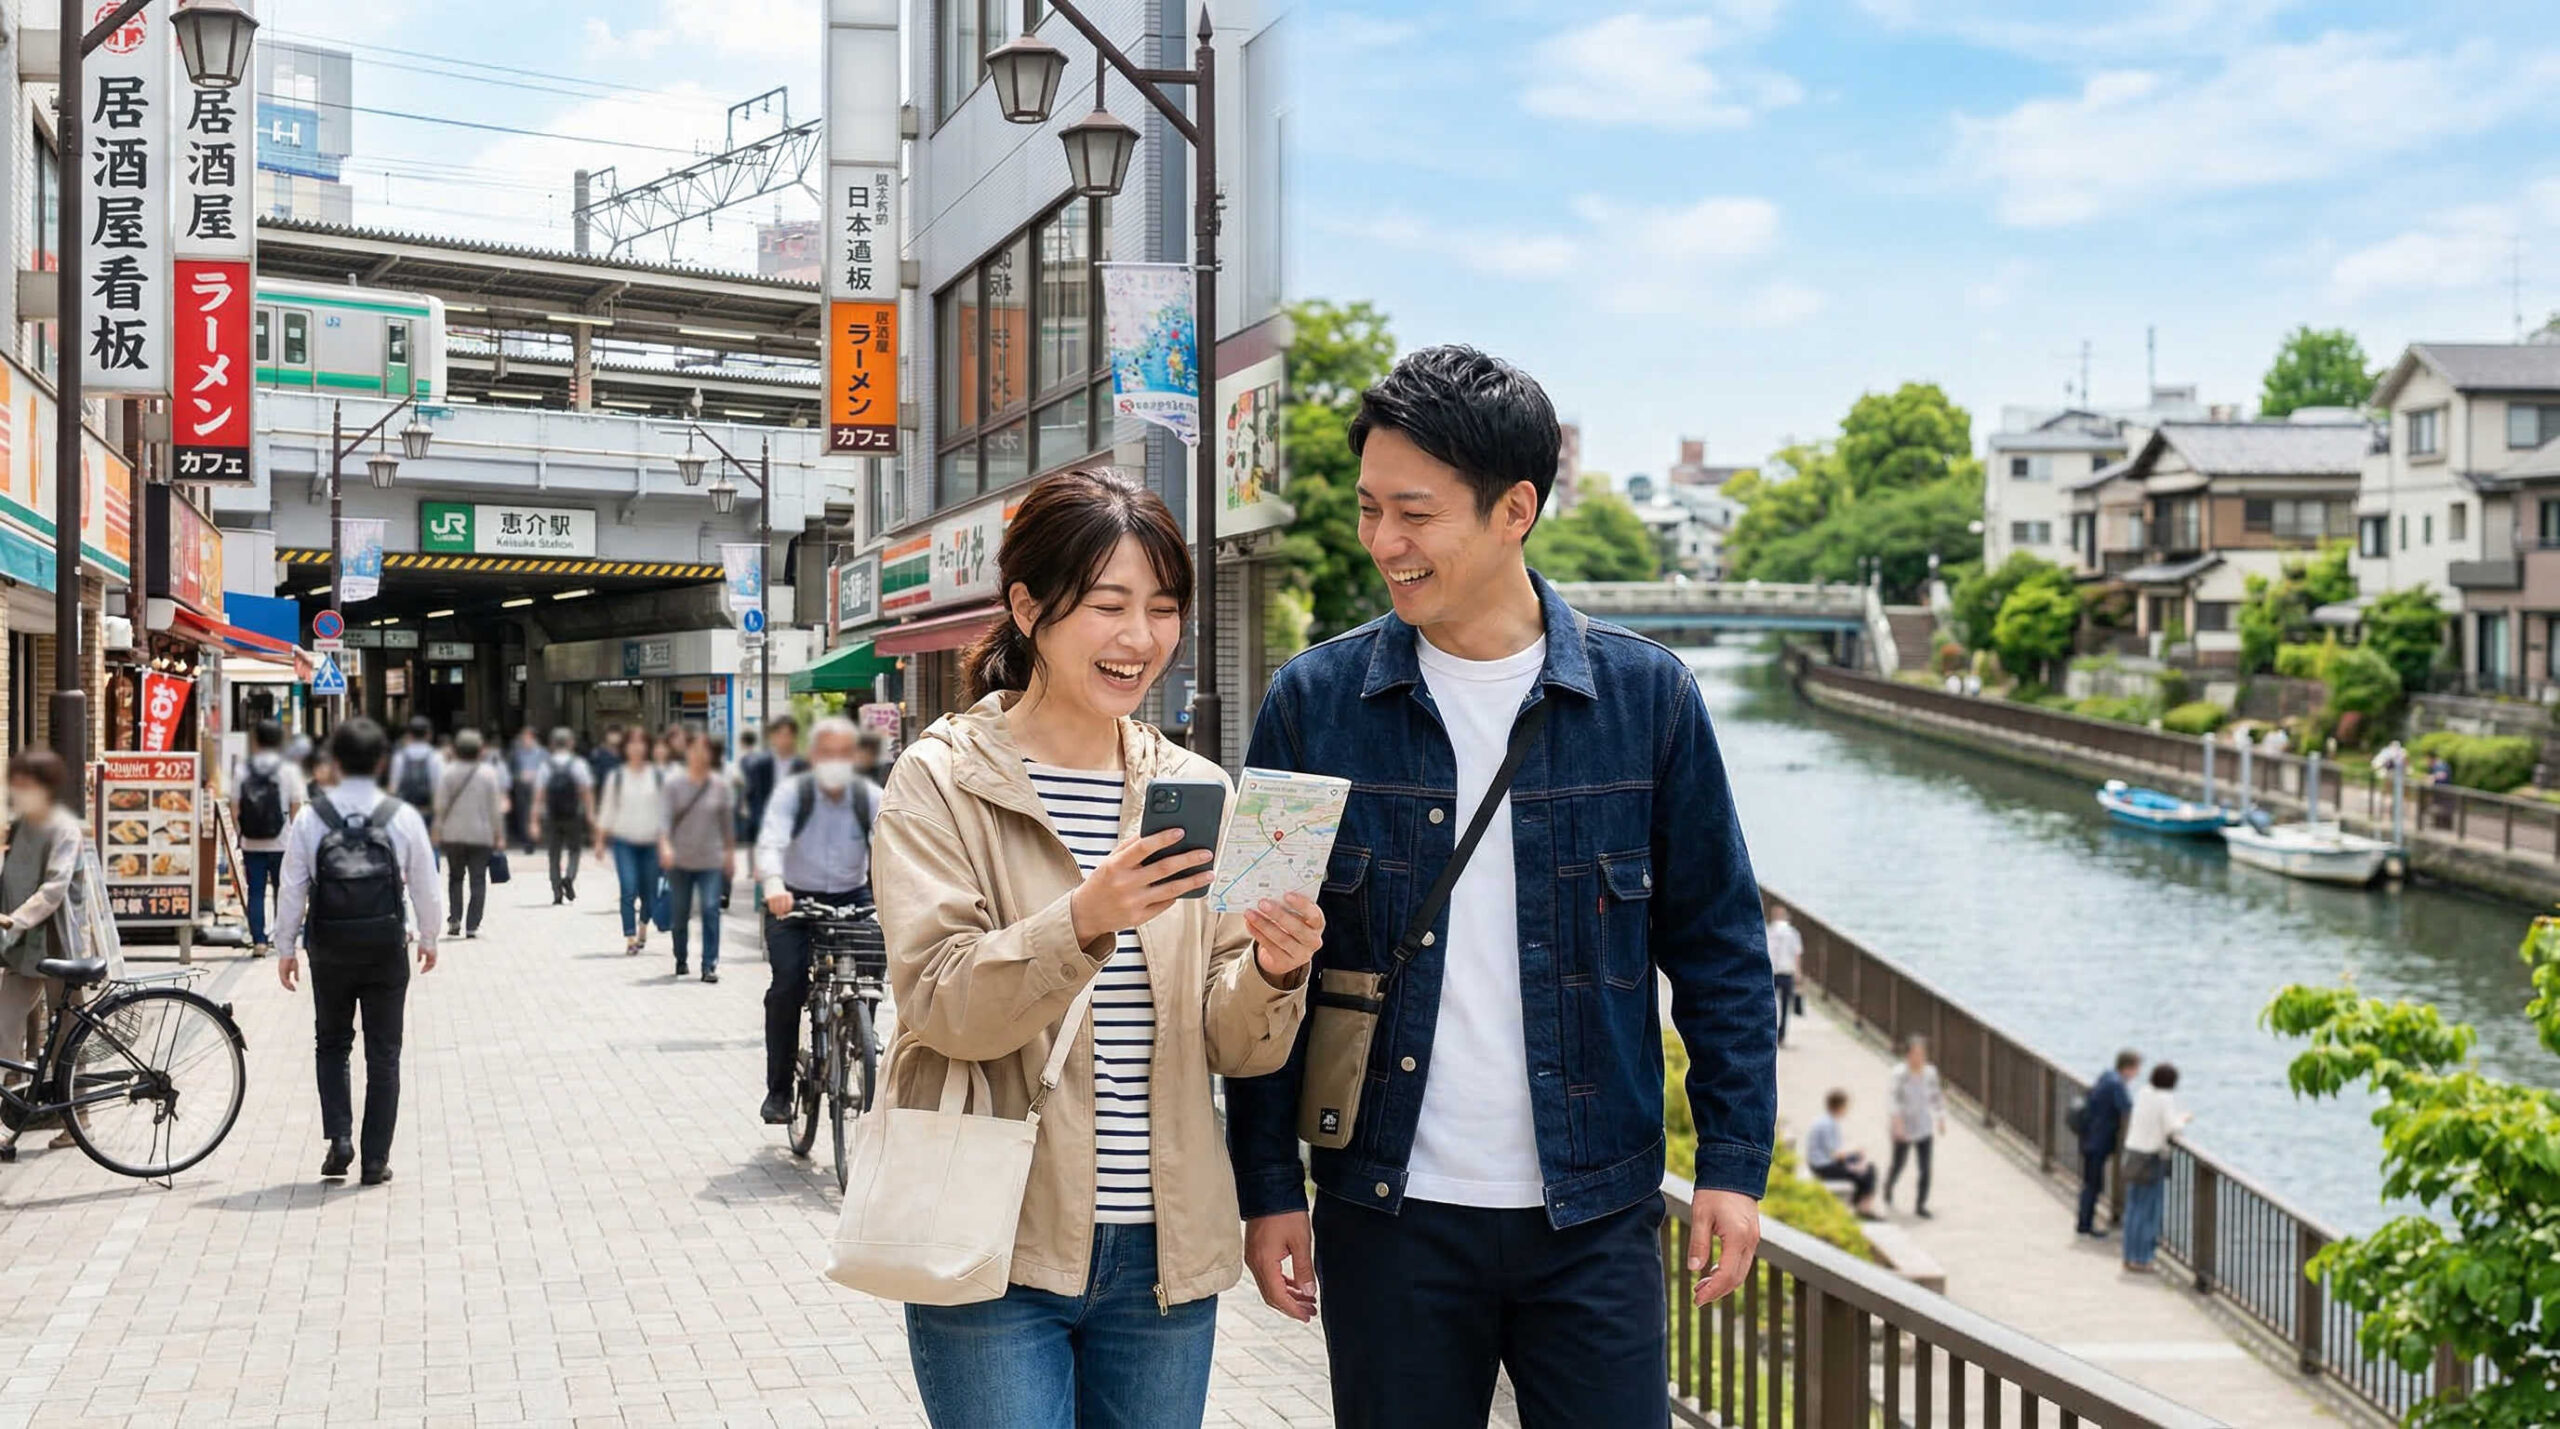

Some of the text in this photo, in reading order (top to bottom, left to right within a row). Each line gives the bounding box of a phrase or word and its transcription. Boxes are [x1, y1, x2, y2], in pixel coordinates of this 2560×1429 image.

[186, 89, 238, 241] 居酒屋
[90, 75, 150, 371] 居酒屋看板
[191, 272, 233, 436] ラーメン
[848, 323, 872, 416] ラーメン
[179, 452, 243, 475] カフェ
[837, 427, 890, 447] カフェ
[430, 512, 467, 535] JR
[501, 511, 571, 537] 恵介駅
